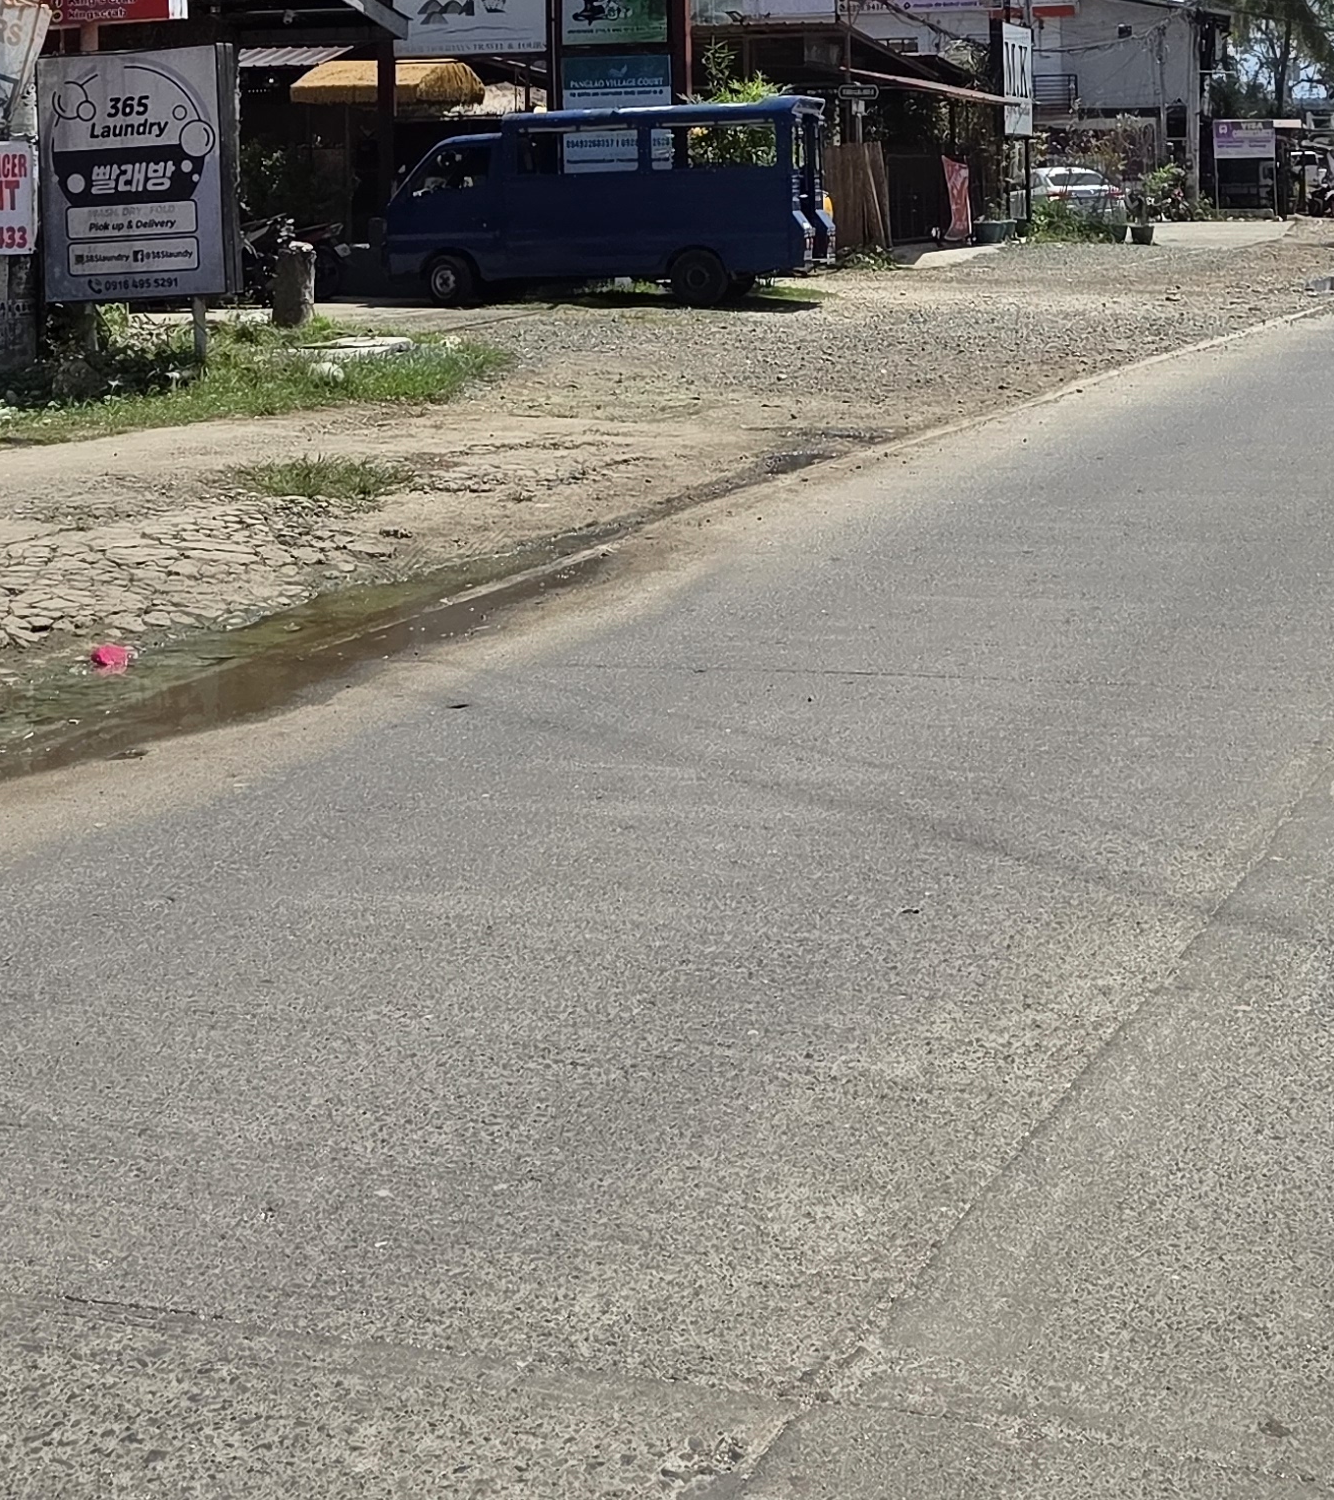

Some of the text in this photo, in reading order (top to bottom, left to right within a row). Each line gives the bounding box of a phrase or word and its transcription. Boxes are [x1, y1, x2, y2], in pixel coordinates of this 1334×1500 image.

[570, 77, 663, 88] PANGLAO VILLAGE COURT
[107, 95, 149, 118] 365
[90, 118, 168, 138] Laundry
[91, 161, 175, 194] 빨래방
[89, 219, 177, 232] Pick up & Delivery
[132, 278, 151, 289] 495
[153, 277, 178, 288] 5291
